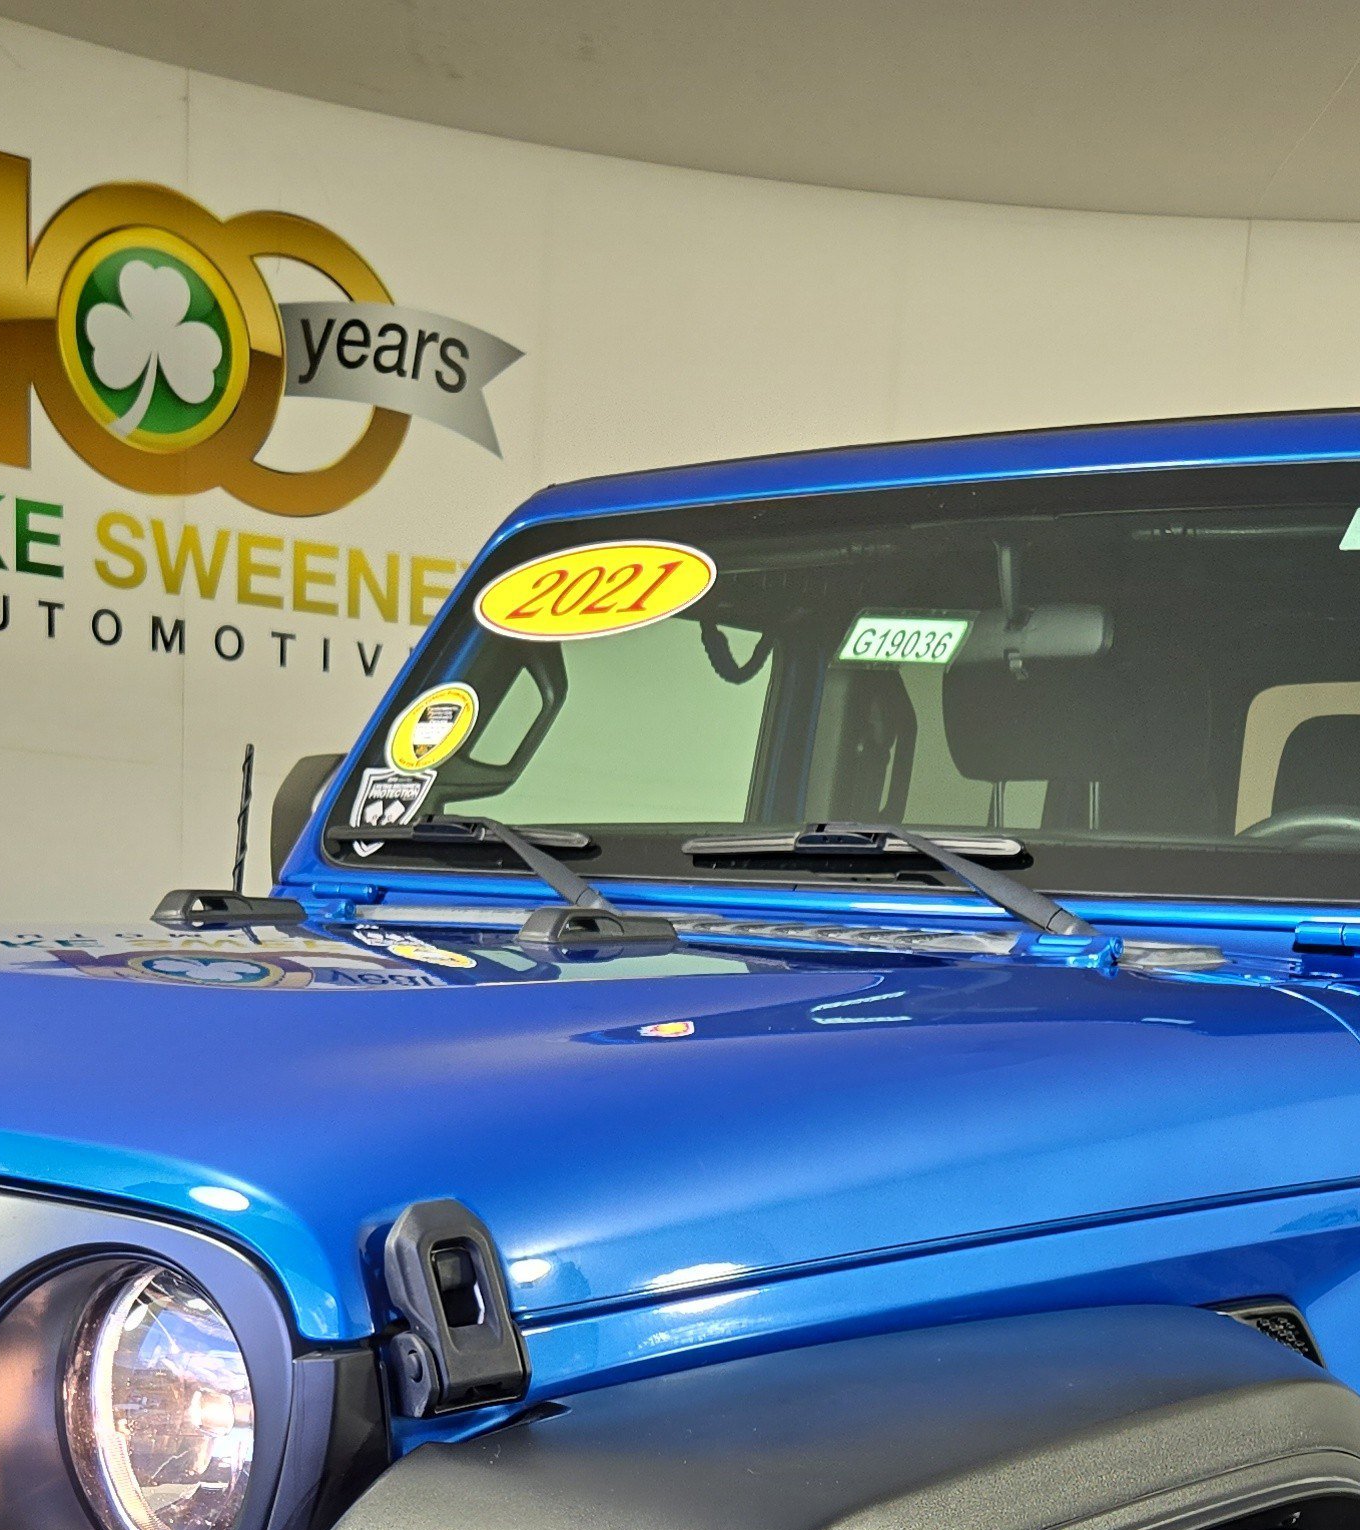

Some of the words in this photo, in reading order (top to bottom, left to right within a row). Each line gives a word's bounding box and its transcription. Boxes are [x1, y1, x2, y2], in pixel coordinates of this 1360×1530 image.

[297, 312, 469, 393] years
[94, 511, 468, 627] SWEENE
[505, 560, 684, 620] 2021
[852, 628, 953, 659] G19036
